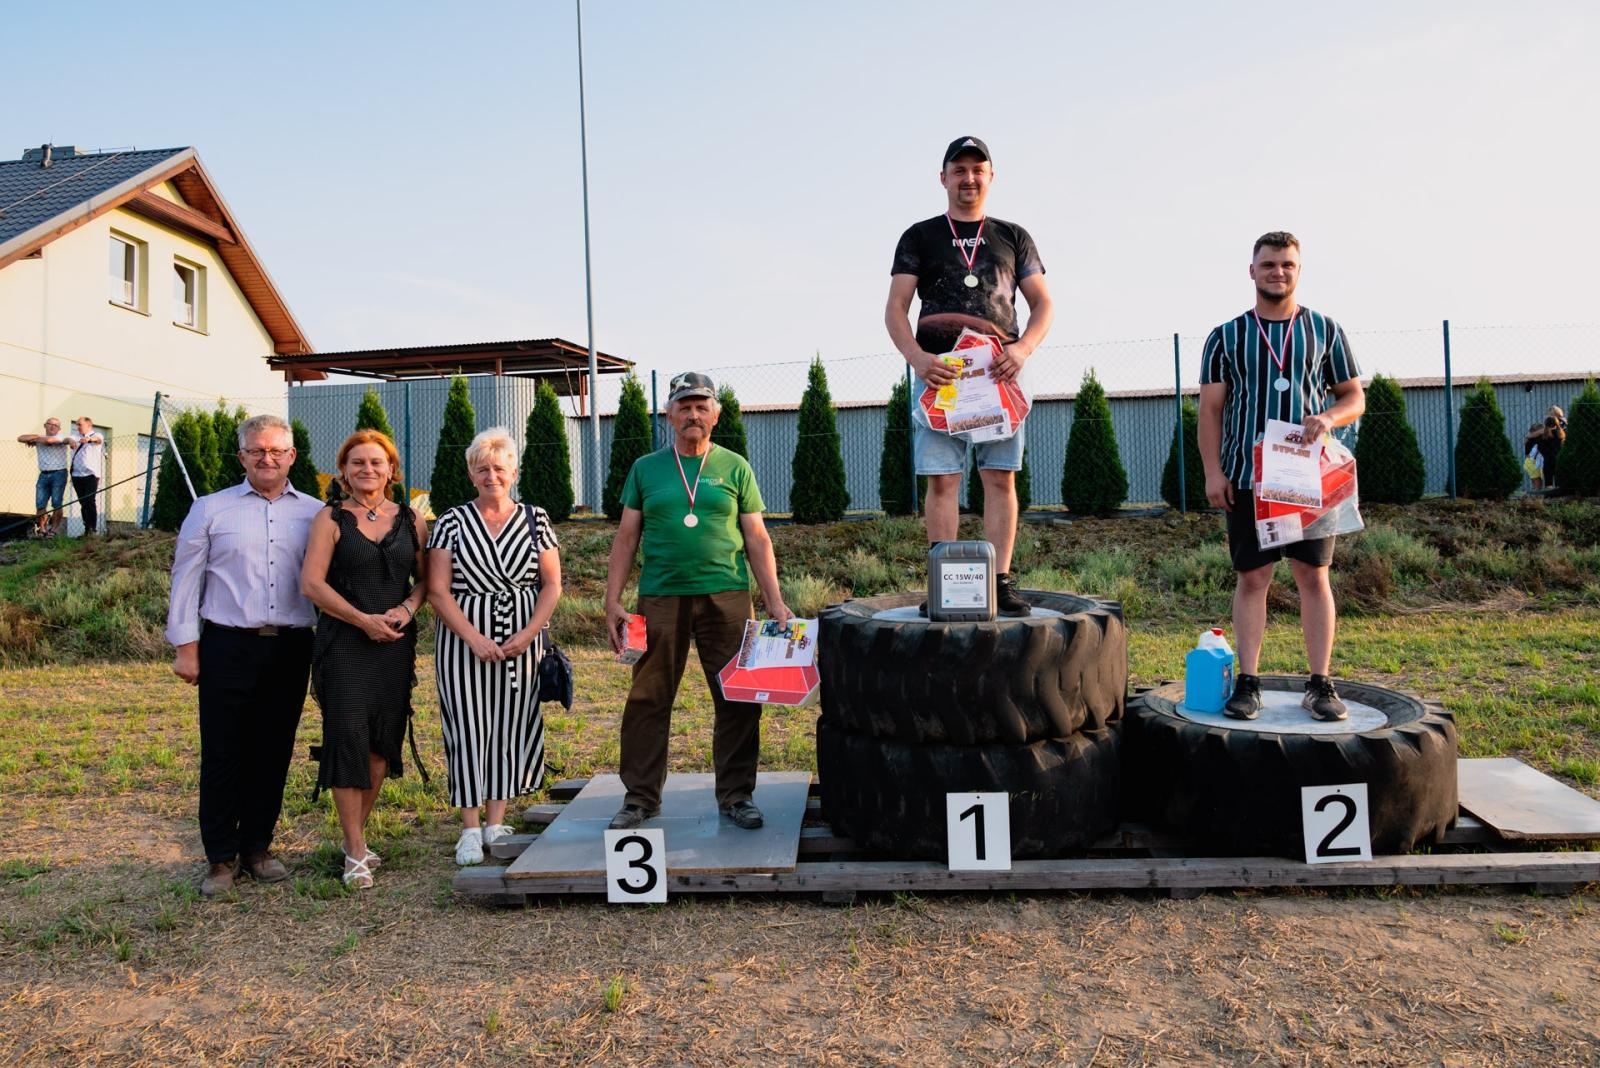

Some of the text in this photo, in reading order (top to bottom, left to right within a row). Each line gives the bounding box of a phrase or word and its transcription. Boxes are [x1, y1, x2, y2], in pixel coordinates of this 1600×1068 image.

[952, 237, 986, 247] NASA
[960, 805, 985, 860] 1
[1314, 794, 1361, 857] 2
[615, 836, 657, 894] 3
